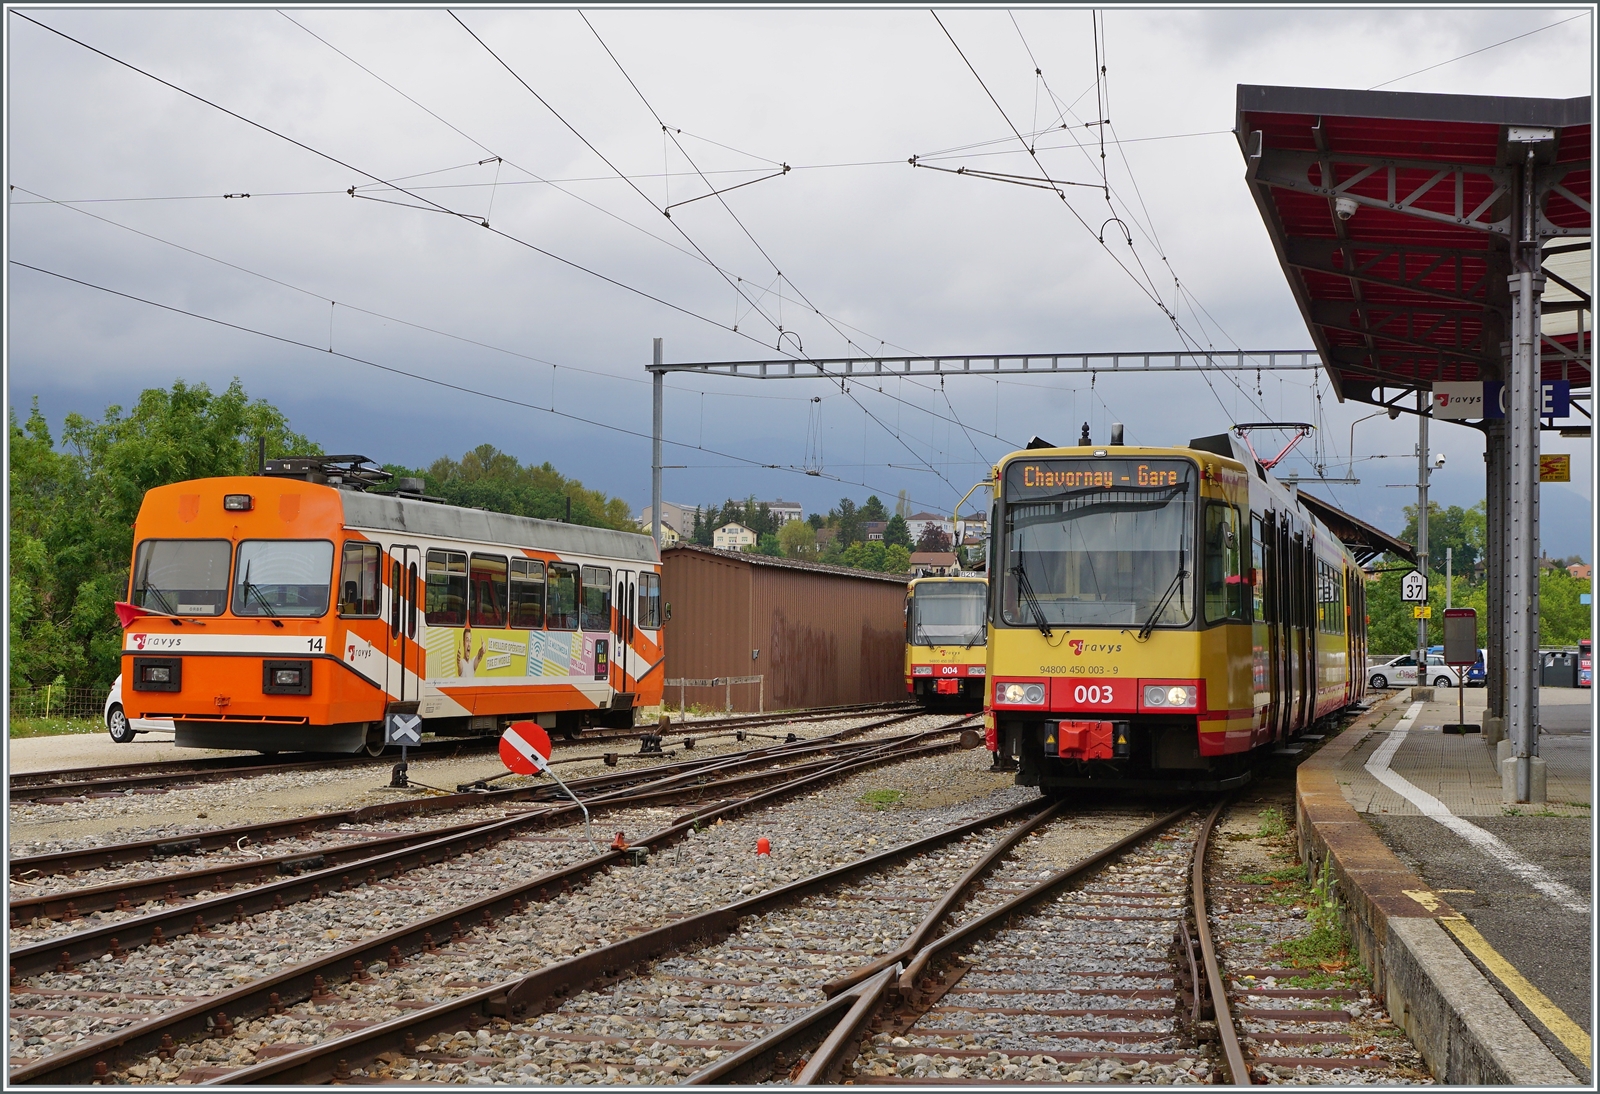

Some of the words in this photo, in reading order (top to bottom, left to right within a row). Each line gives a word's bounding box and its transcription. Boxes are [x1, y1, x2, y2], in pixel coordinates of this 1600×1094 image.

[1024, 465, 1113, 488] Chavornay
[1137, 464, 1177, 486] Gare
[1410, 575, 1419, 583] m
[1406, 584, 1422, 599] 37
[133, 634, 182, 649] travys
[307, 638, 323, 652] 14
[1069, 640, 1122, 656] travys
[348, 645, 372, 661] travys
[597, 664, 606, 673] BLO
[942, 666, 958, 674] 004
[1039, 665, 1067, 674] 94800
[1069, 665, 1086, 674] 450
[1088, 665, 1104, 674] 003
[1113, 666, 1119, 674] 9
[1074, 685, 1113, 704] 003
